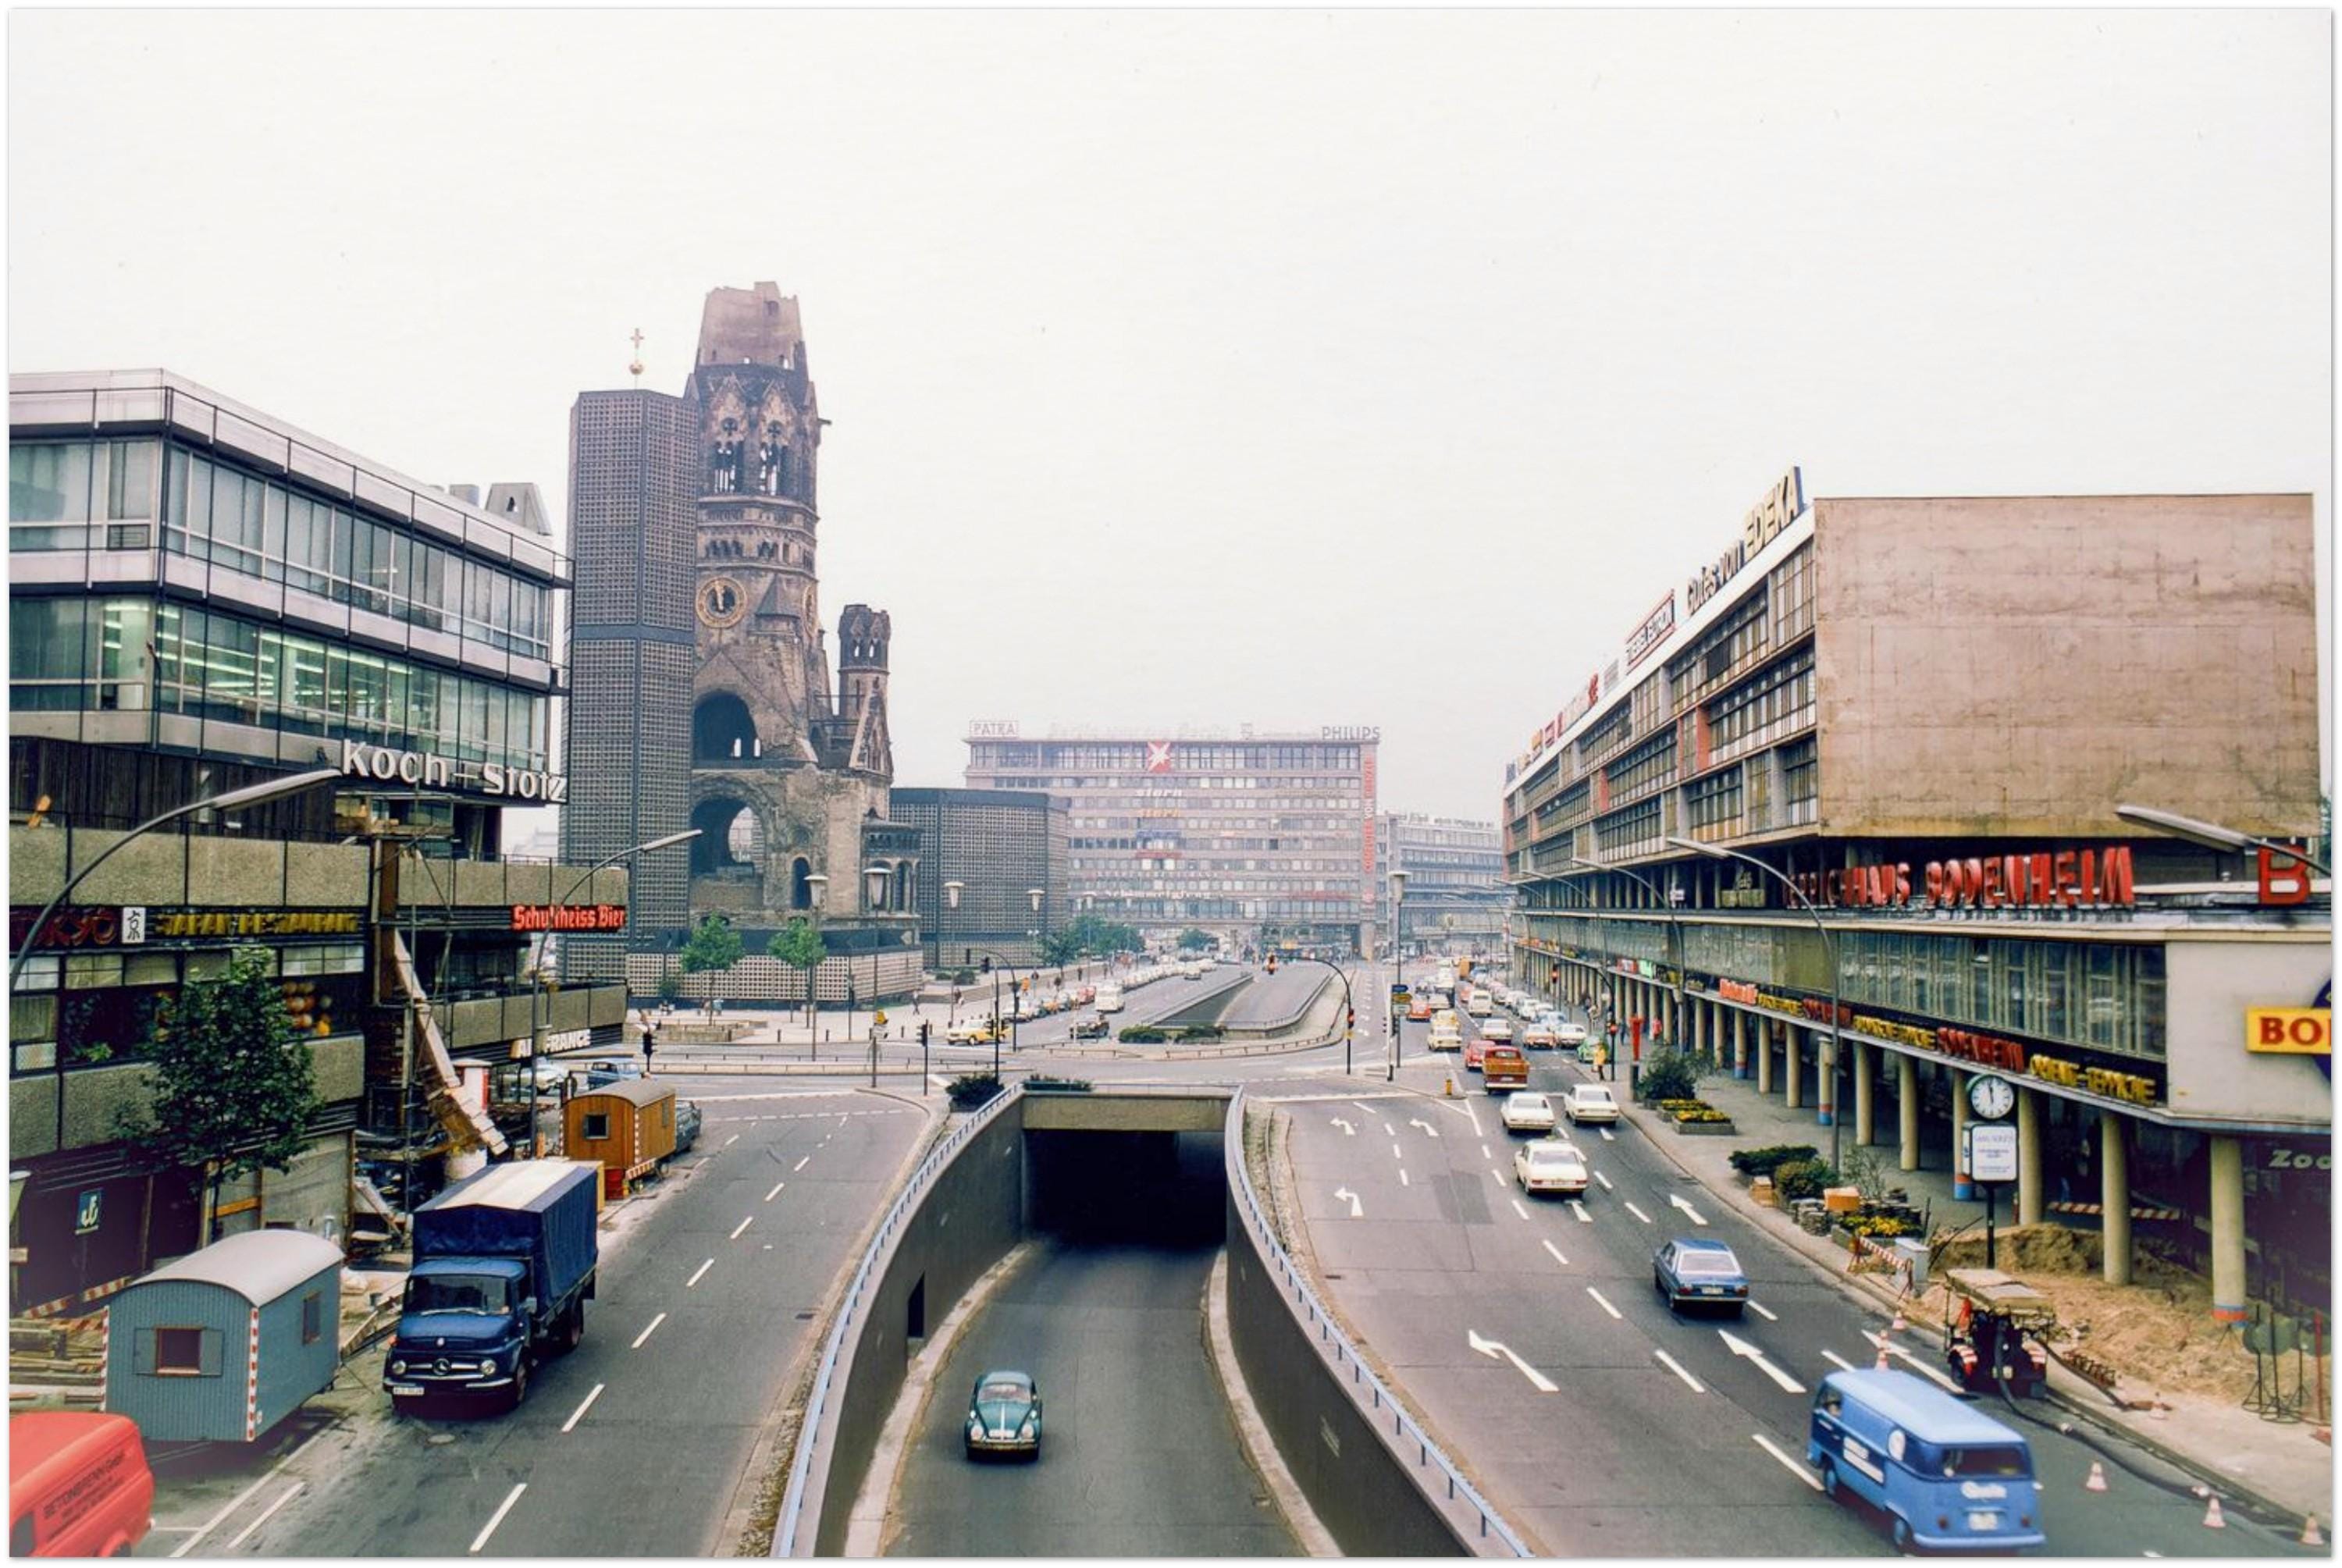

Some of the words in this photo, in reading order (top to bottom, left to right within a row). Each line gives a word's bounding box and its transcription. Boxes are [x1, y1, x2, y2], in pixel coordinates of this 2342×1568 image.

[1687, 567, 1720, 618] Gutes
[1719, 540, 1745, 587] von
[1743, 465, 1805, 563] EDEKA
[973, 723, 1016, 736] PATRA
[1322, 726, 1380, 740] PHILIPS
[343, 739, 447, 787] Koch
[483, 762, 568, 802] Stotz
[1135, 788, 1183, 797] stern
[1137, 808, 1181, 817] stern
[1925, 847, 2134, 907] BODENHEIM
[2258, 844, 2310, 904] B
[598, 902, 625, 927] Bier
[543, 1029, 591, 1054] FRANCE
[2259, 1017, 2331, 1046] BO
[2269, 1150, 2332, 1170] Zoo
